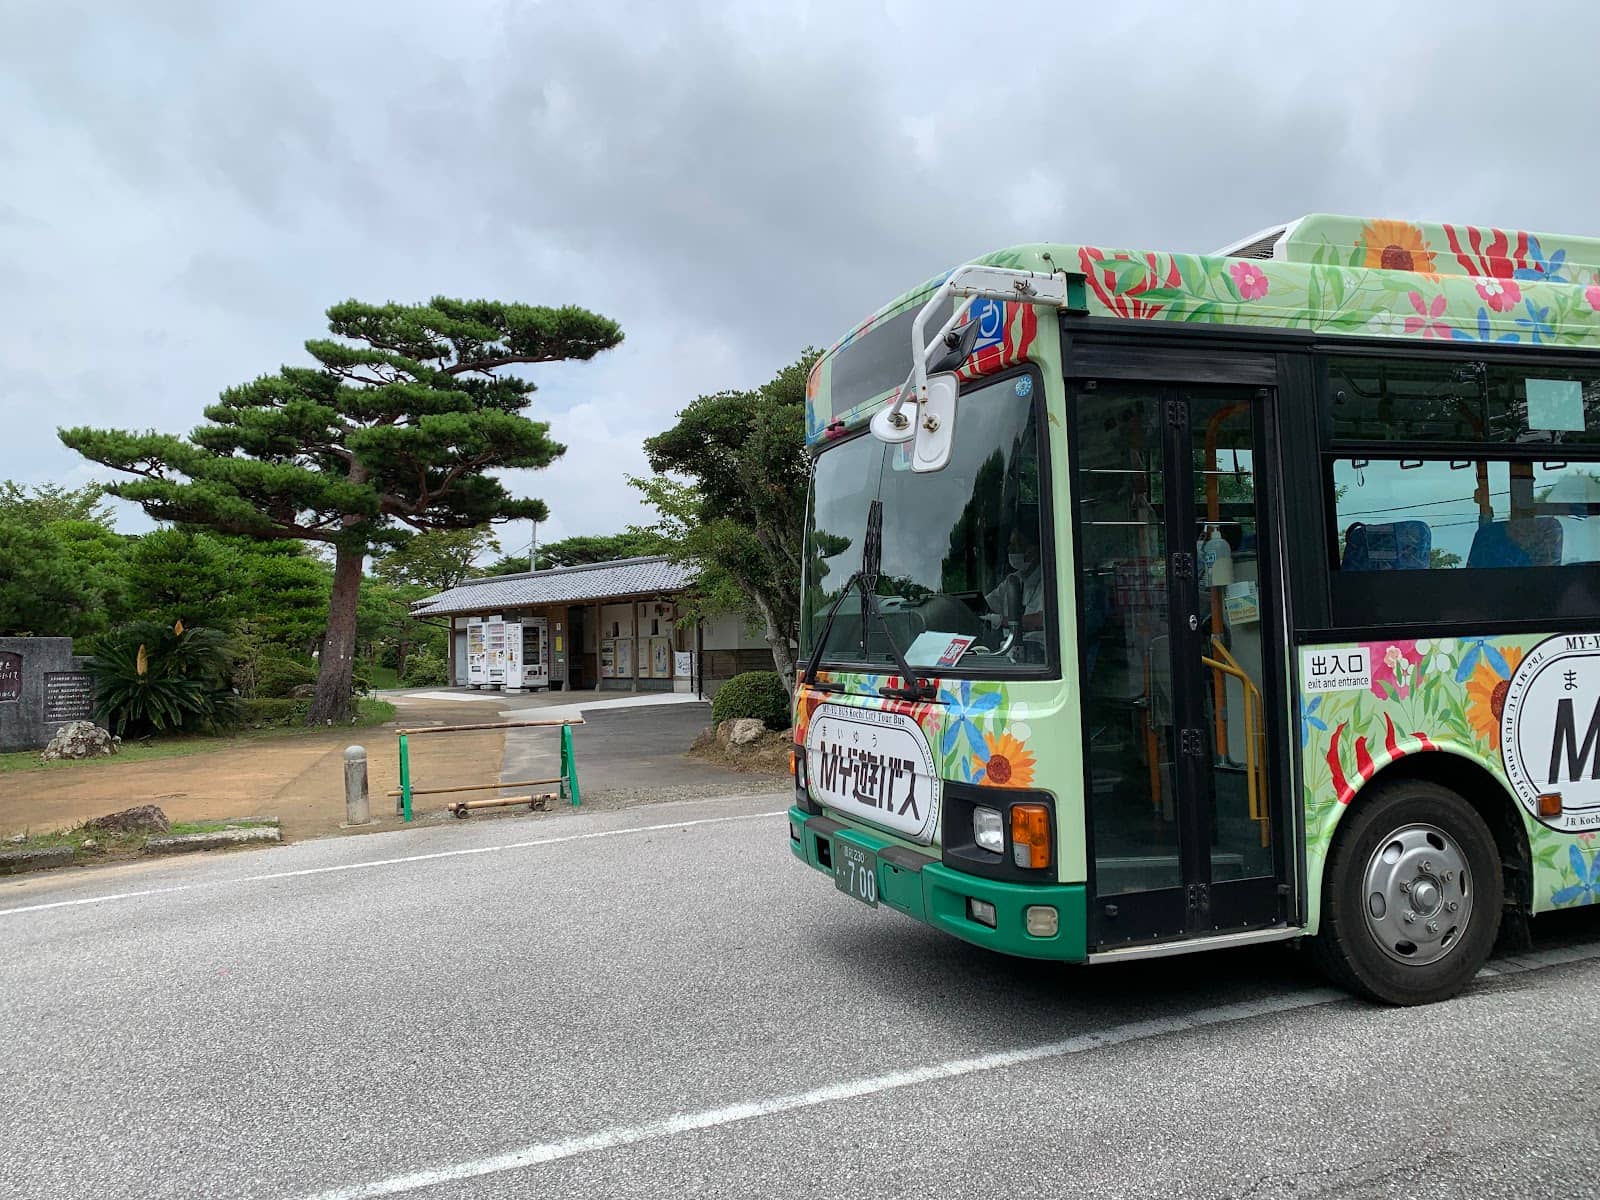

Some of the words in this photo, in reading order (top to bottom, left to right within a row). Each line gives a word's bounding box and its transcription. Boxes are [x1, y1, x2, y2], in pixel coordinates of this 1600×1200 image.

[1312, 655, 1363, 675] 出入口
[1528, 652, 1544, 669] The
[1308, 679, 1321, 689] exit
[1323, 679, 1336, 688] and
[1338, 677, 1369, 687] entrance
[1563, 669, 1578, 690] ま
[878, 713, 892, 722] Tour
[893, 714, 905, 725] Bus
[1505, 717, 1513, 743] BUS
[1507, 748, 1518, 778] runs
[1516, 780, 1536, 806] from
